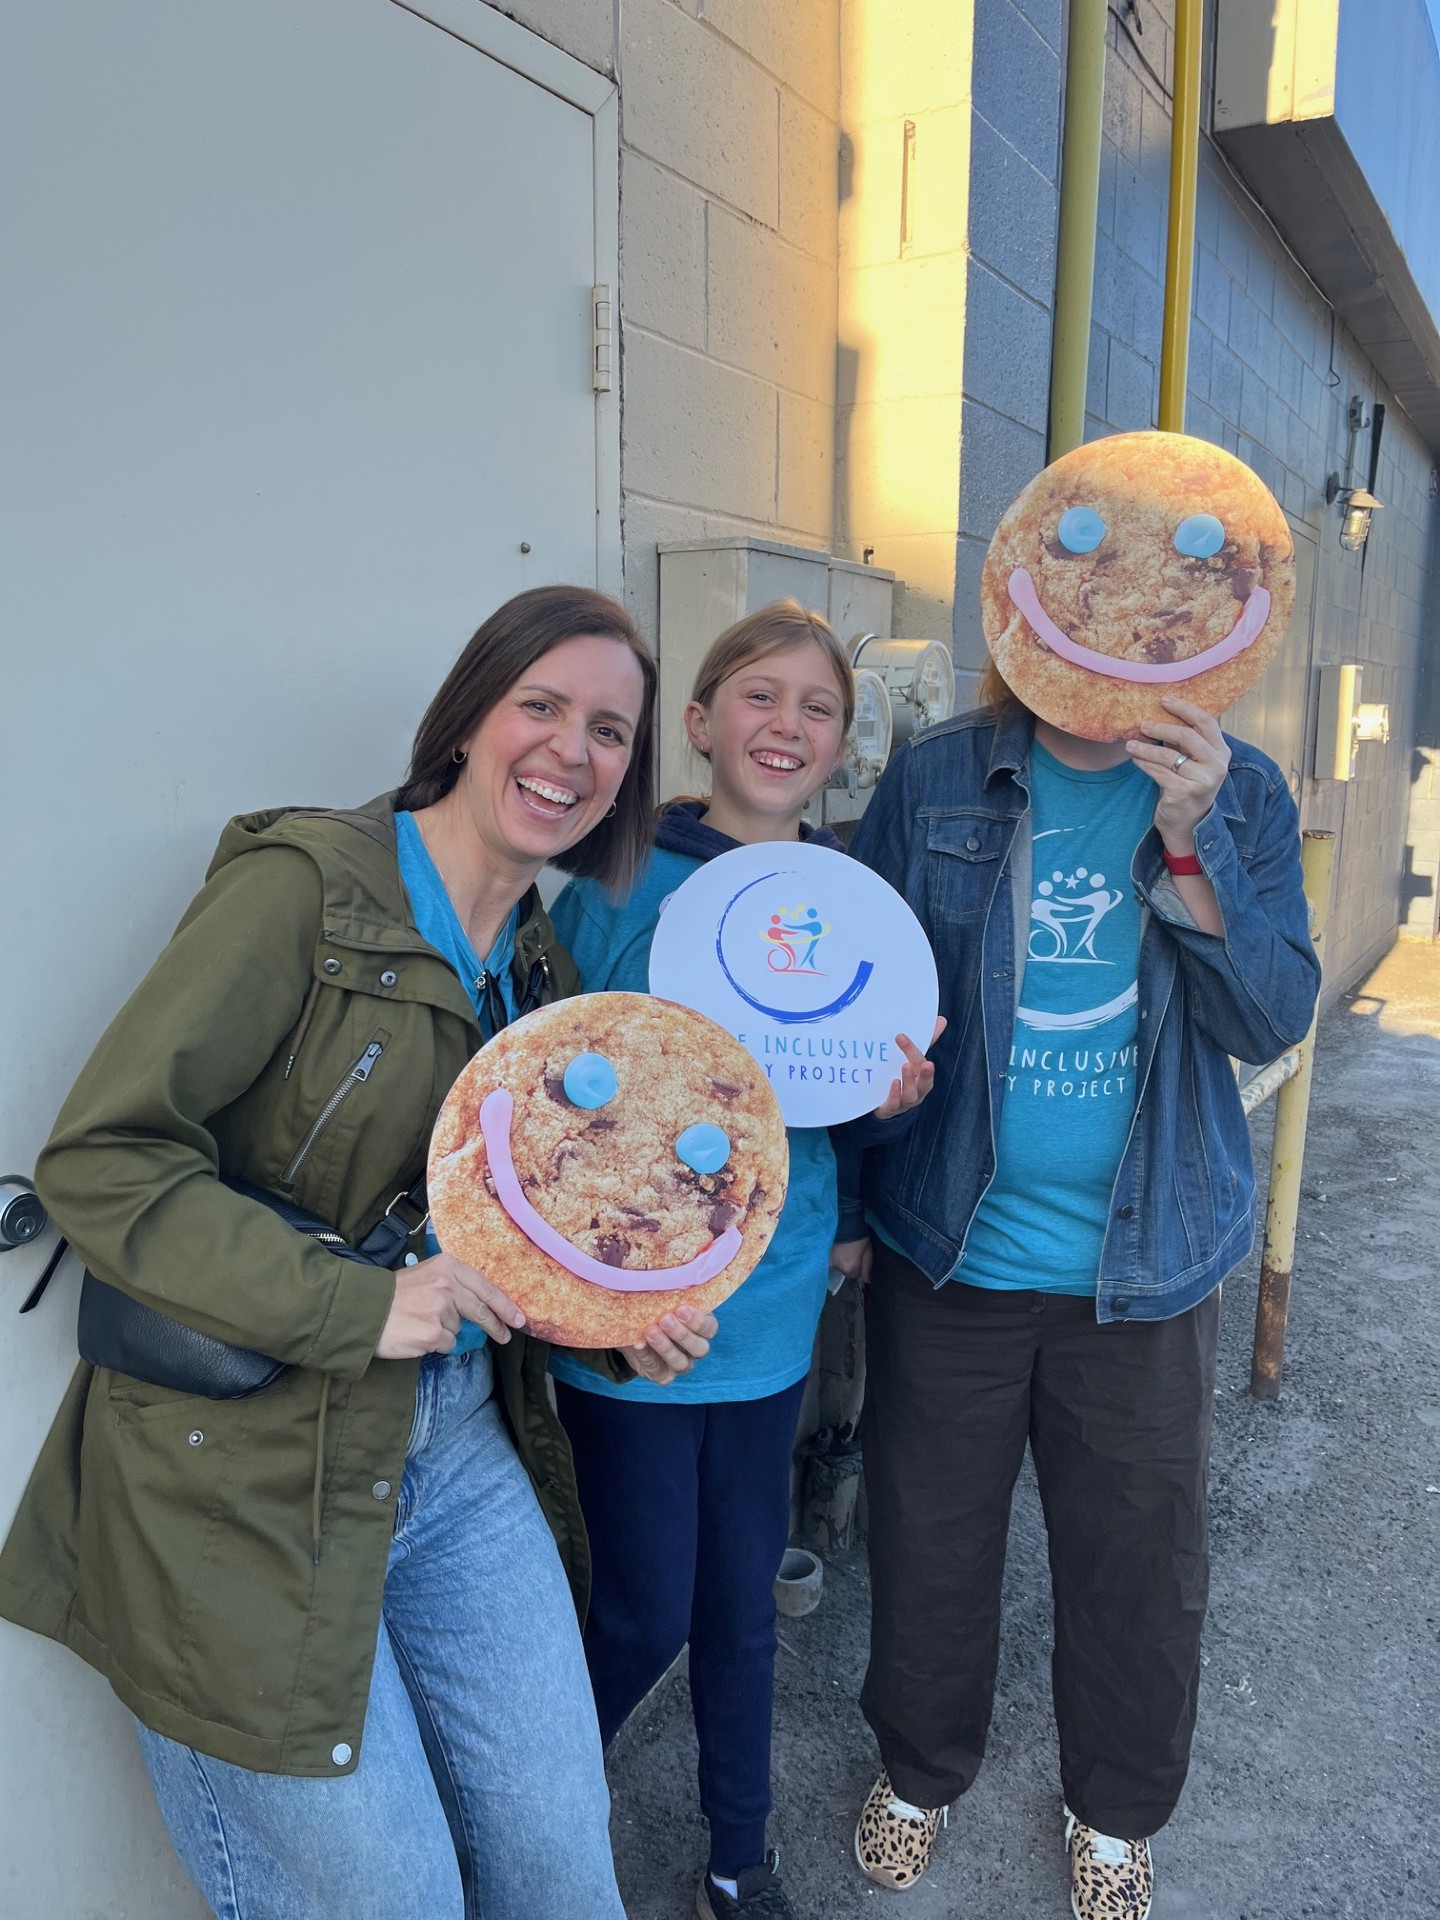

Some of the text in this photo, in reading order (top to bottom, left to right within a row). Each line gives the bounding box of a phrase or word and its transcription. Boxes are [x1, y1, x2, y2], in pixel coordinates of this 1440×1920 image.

[764, 1034, 888, 1061] INCLUSIVE
[789, 1064, 873, 1084] PROJECT
[1033, 1077, 1126, 1098] PROJECT
